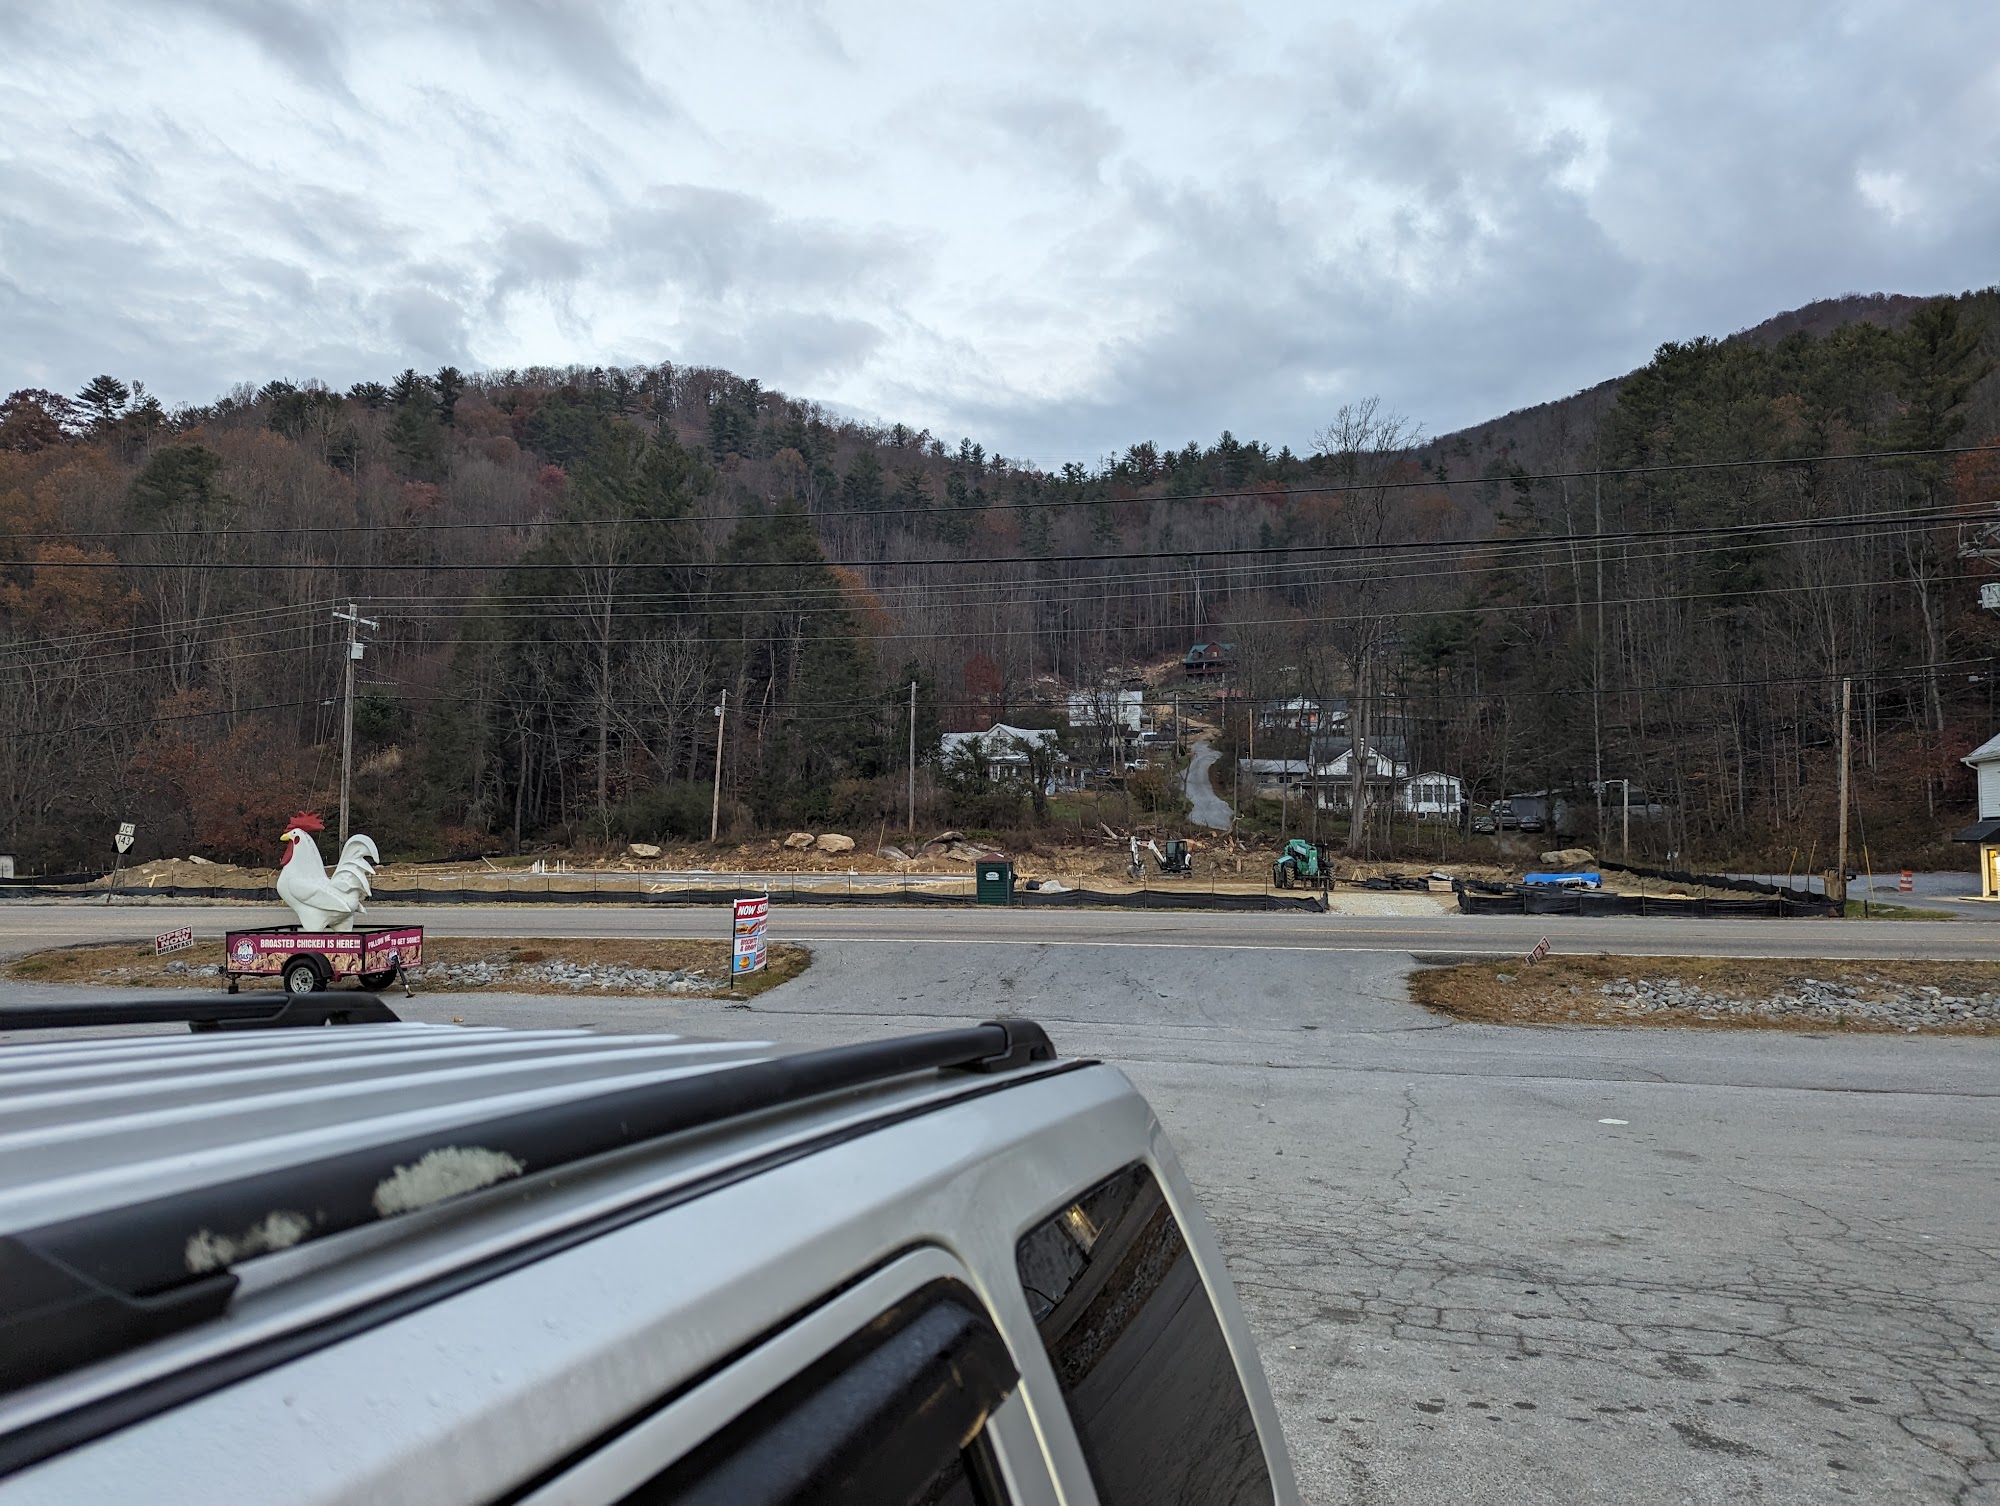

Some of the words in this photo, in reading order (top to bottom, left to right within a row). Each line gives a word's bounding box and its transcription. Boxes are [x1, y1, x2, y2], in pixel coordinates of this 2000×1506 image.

[120, 824, 133, 834] JCT
[117, 835, 131, 845] 143
[737, 905, 756, 916] NOW
[157, 927, 191, 942] OPEN
[160, 933, 189, 947] NOW
[260, 939, 294, 948] BROASTED
[296, 939, 326, 948] CHICKEN
[327, 939, 335, 948] IS
[367, 937, 384, 949] FOLLOW
[384, 933, 391, 942] ME
[391, 938, 397, 946] TO
[397, 937, 406, 946] GET
[157, 940, 192, 954] BREAKFAST
